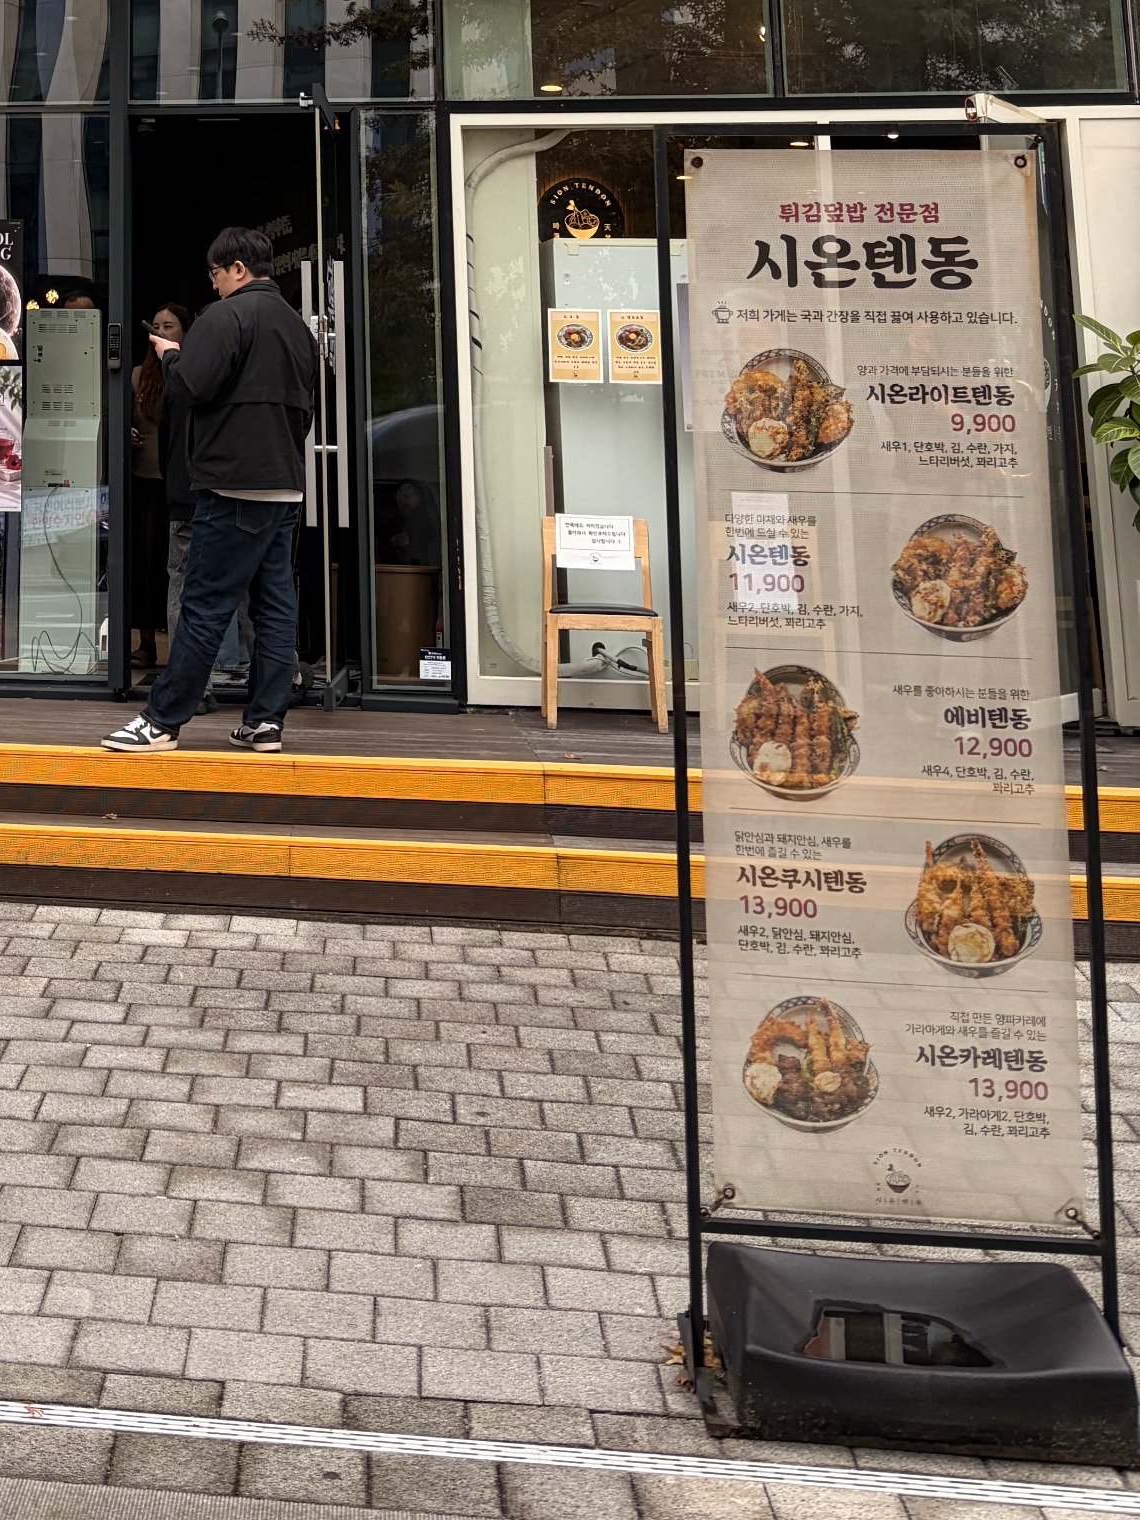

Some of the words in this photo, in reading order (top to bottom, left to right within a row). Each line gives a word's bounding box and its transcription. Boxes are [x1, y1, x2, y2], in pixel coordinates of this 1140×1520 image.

[550, 185, 569, 205] SION
[574, 183, 612, 207] TENDON
[779, 202, 867, 223] 튀김덮밥
[874, 202, 940, 223] 전문점
[747, 234, 979, 290] 시온텐동
[737, 309, 759, 323] 저희
[763, 310, 798, 324] 가게는
[800, 310, 824, 323] 국과
[827, 311, 861, 324] 간장을
[864, 311, 888, 324] 직접
[890, 311, 913, 324] 끓여
[917, 311, 964, 325] 사용하고
[967, 311, 1018, 325] 있습니다.
[857, 365, 877, 376] 양과
[879, 365, 909, 377] 가격에
[911, 366, 959, 377] 부담되시는
[962, 366, 991, 378] 분들을
[994, 366, 1014, 378] 위한
[866, 383, 1015, 406] 시온라이트텐동
[951, 413, 1016, 435] 9,900
[881, 441, 911, 453] 새우1,
[913, 442, 948, 454] 단호박,
[950, 442, 964, 454] 김,
[966, 442, 991, 455] 수란,
[993, 443, 1018, 456] 가지,
[918, 456, 973, 468] 느타리버섯,
[976, 457, 1018, 469] 꽈리고추
[724, 513, 754, 525] 다양한
[787, 515, 817, 527] 새우를
[725, 526, 755, 538] 한번에
[756, 527, 776, 539] 드실
[778, 528, 789, 539] 수
[790, 528, 810, 540] 있는
[726, 543, 811, 567] 시온텐동
[728, 572, 805, 595] 11,900
[727, 601, 758, 614] 새우2,
[760, 602, 794, 615] 단호박,
[796, 604, 810, 616] 김,
[812, 604, 837, 617] 수란,
[838, 605, 863, 618] 가지,
[727, 615, 782, 629] 느타리버섯,
[784, 617, 827, 629] 꽈리고추
[892, 684, 923, 697] 새우를
[924, 685, 975, 699] 좋아하시는
[977, 687, 1008, 701] 분들을
[1009, 688, 1030, 701] 위한
[943, 705, 1031, 730] 에비텐동
[954, 736, 1033, 759] 12,900
[921, 764, 953, 778] 새우4,
[955, 766, 991, 780] 단호박,
[993, 767, 1007, 780] 김,
[1009, 768, 1035, 781] 수란,
[992, 782, 1035, 795] 꽈리고추
[734, 830, 775, 844] 닭안심과
[776, 833, 820, 847] 돼지안심,
[821, 836, 852, 849] 새우를
[735, 844, 765, 857] 한번에
[767, 846, 787, 859] 즐길
[789, 848, 800, 859] 수
[802, 848, 822, 861] 있는
[736, 864, 867, 893] 시온쿠시텐동
[739, 895, 818, 919] 13,900
[738, 924, 769, 939] 새우2,
[771, 926, 807, 941] 닭안심,
[809, 930, 855, 944] 돼지안심,
[738, 938, 773, 954] 단호박,
[776, 941, 790, 955] 김,
[792, 943, 817, 957] 수란,
[819, 945, 863, 959] 꽈리고추
[949, 1011, 970, 1023] 직접
[972, 1012, 993, 1025] 만든
[995, 1013, 1046, 1027] 양파카레에
[905, 1023, 956, 1036] 가라아게와
[957, 1026, 989, 1039] 새우를
[990, 1027, 1011, 1041] 즐길
[1013, 1029, 1024, 1041] 수
[1026, 1029, 1047, 1042] 있는
[915, 1044, 1048, 1073] 시온카레텐동
[968, 1077, 1049, 1102] 13,900
[923, 1105, 956, 1119] 새우2,
[958, 1108, 1012, 1123] 가라아게2,
[1014, 1110, 1050, 1125] 단호박,
[963, 1123, 977, 1136] 김,
[980, 1125, 1005, 1137] 수란,
[1007, 1126, 1051, 1139] 꽈리고추
